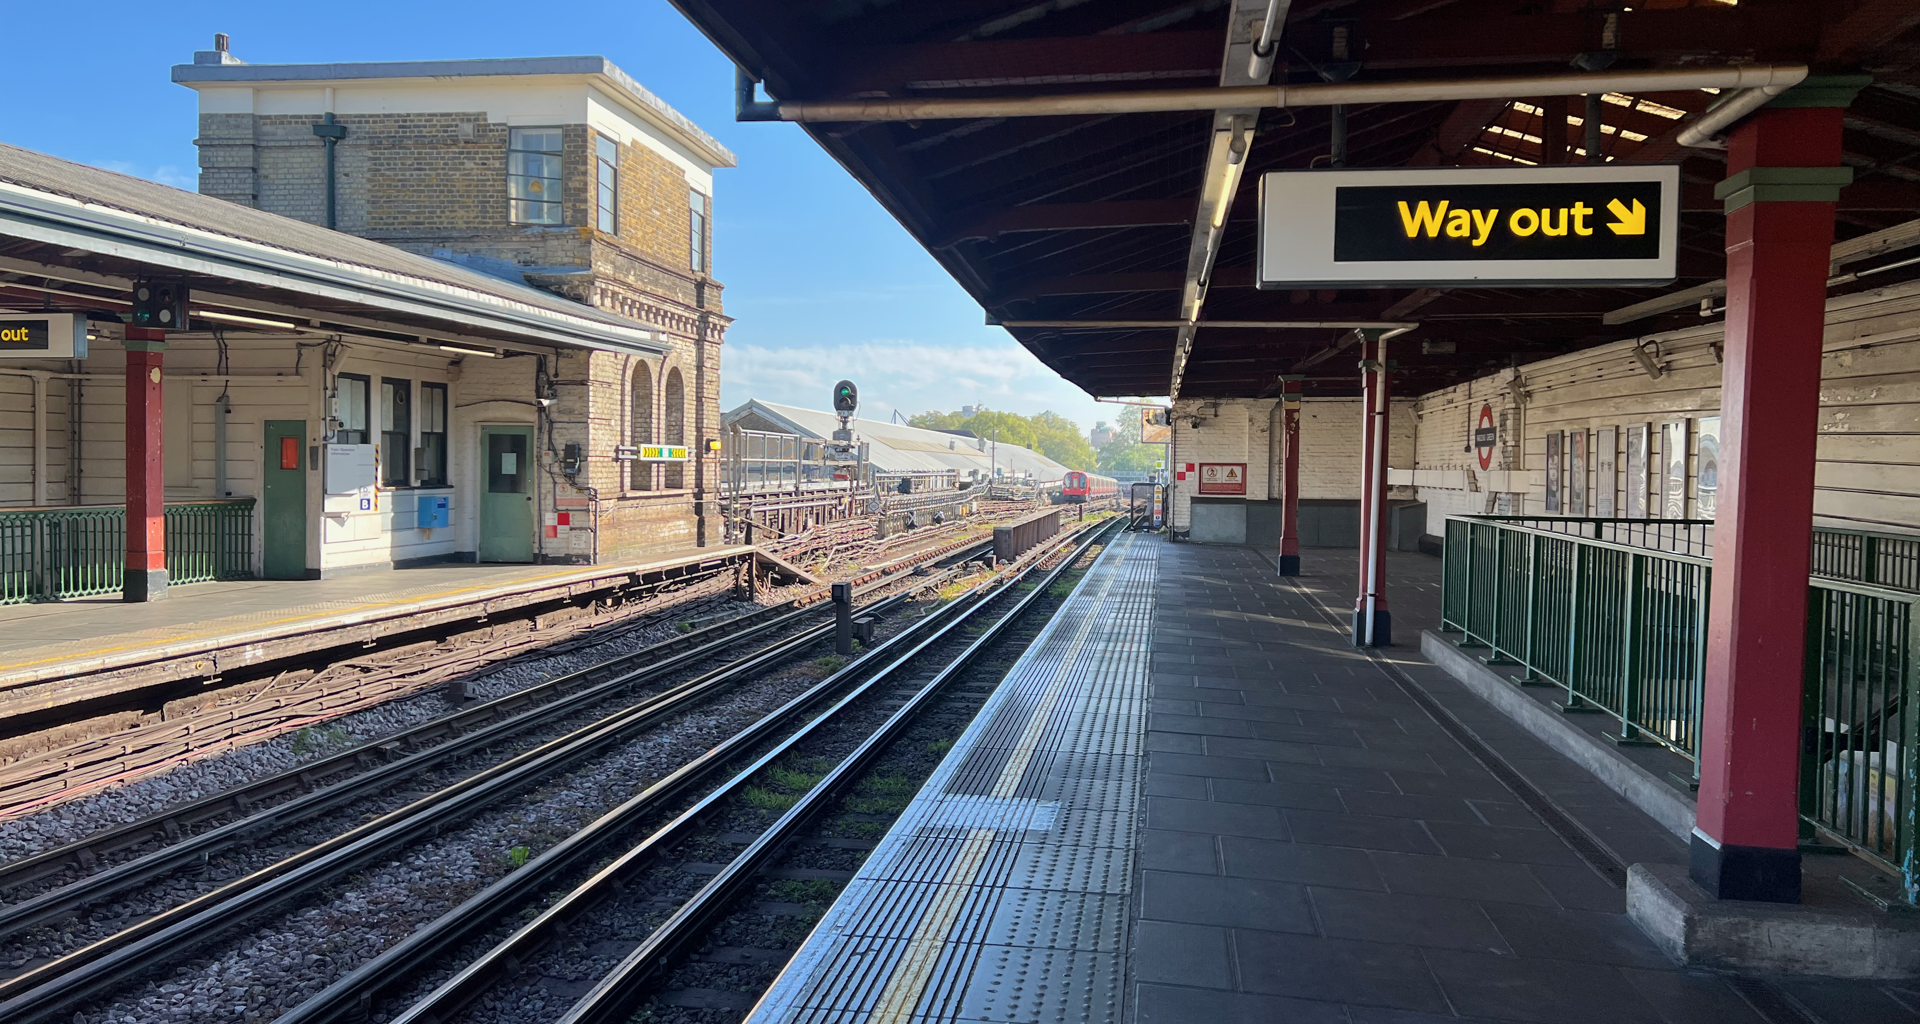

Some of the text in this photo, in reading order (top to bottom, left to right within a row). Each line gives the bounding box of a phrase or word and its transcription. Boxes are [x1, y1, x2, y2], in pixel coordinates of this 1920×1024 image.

[1397, 200, 1594, 246] Way out
[1, 326, 29, 341] out
[361, 499, 369, 509] B
